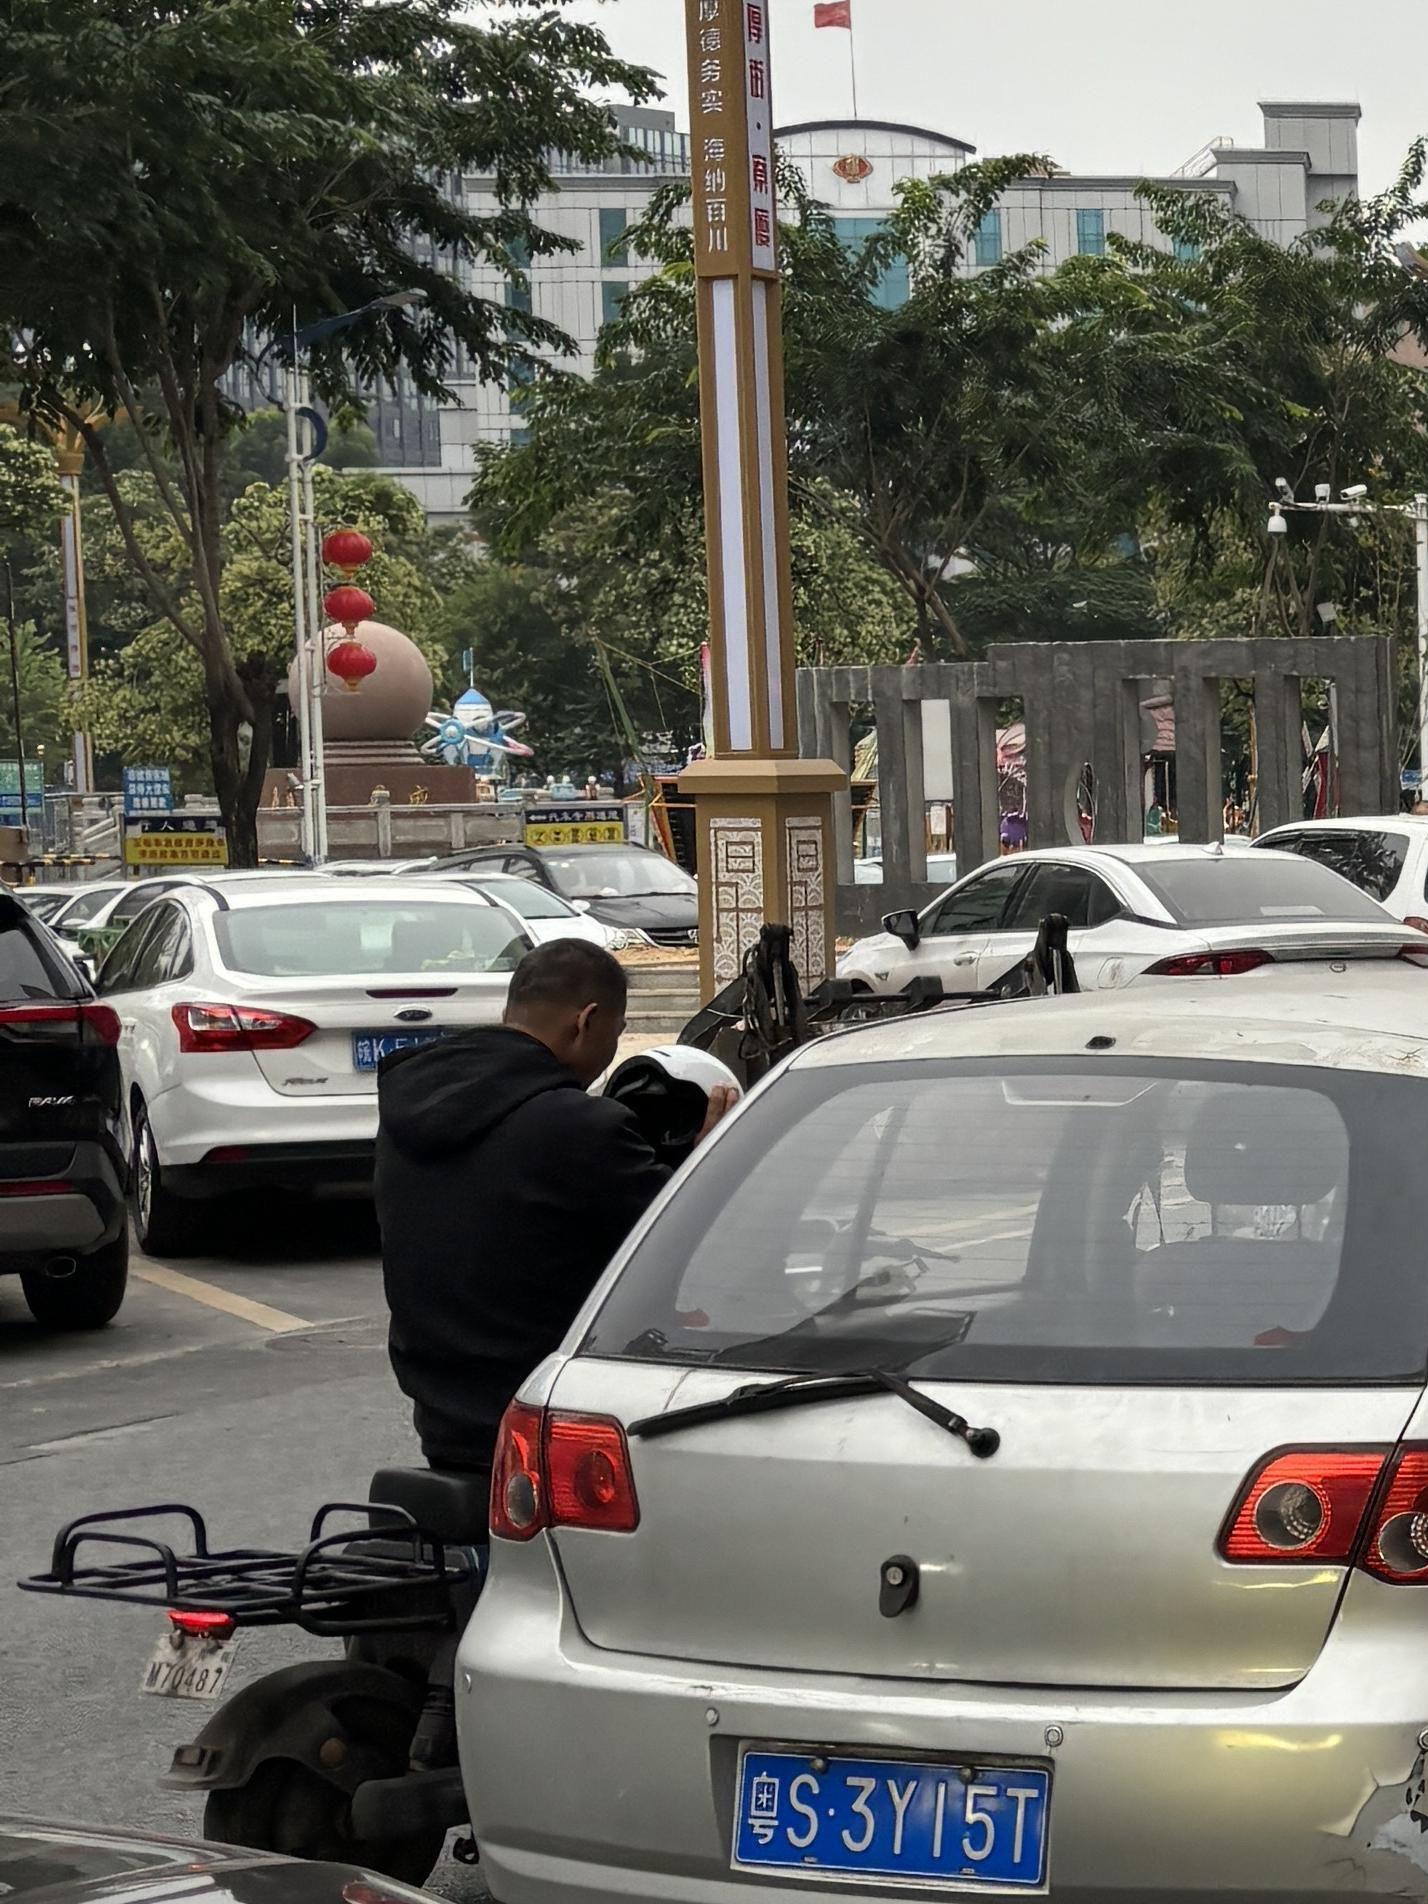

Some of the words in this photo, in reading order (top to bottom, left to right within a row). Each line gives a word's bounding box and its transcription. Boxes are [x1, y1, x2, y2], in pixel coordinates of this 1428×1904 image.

[703, 138, 729, 253] 海纳百川
[748, 1770, 1040, 1864] 粤S·3Y15T
